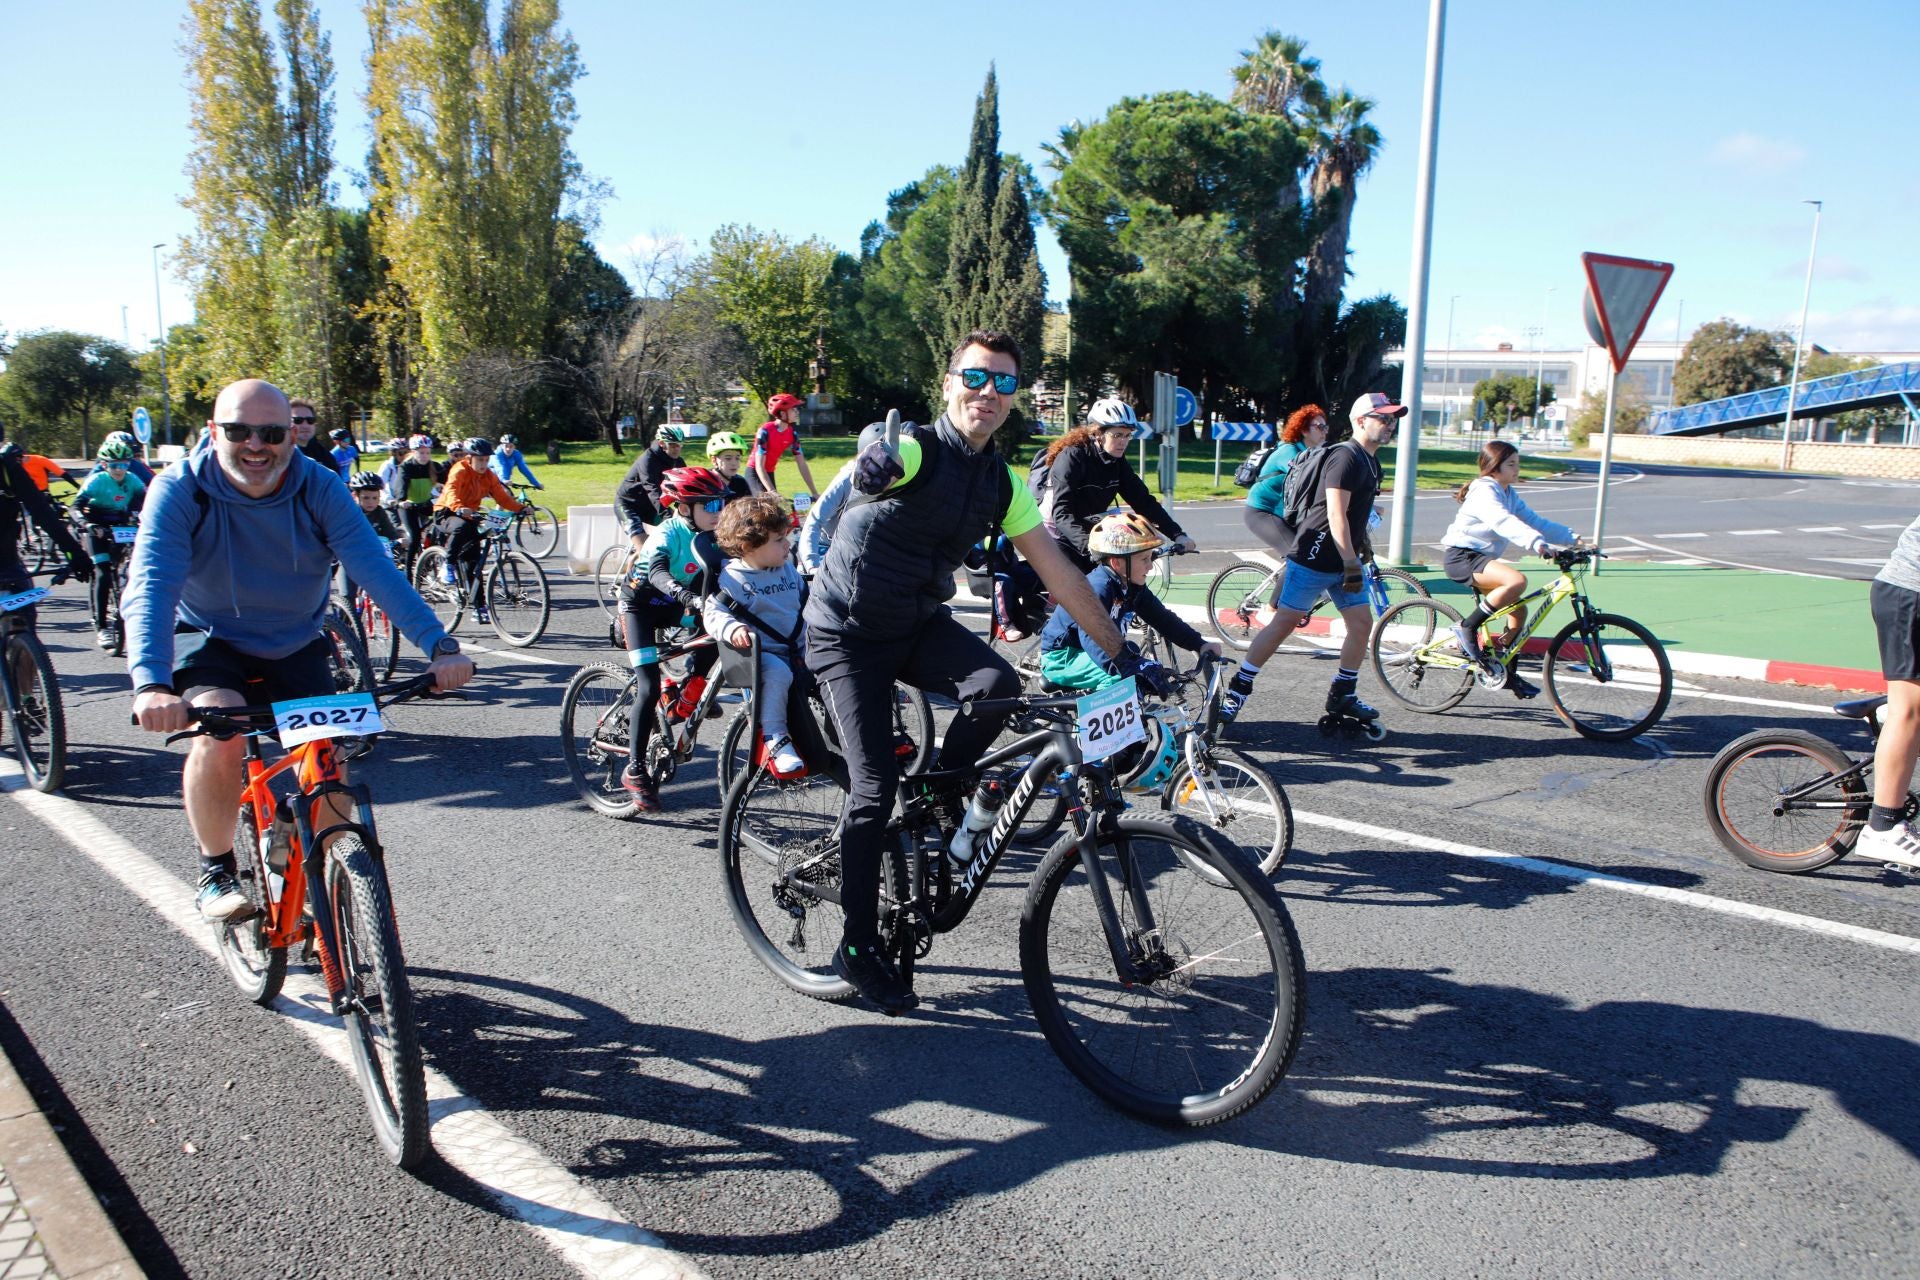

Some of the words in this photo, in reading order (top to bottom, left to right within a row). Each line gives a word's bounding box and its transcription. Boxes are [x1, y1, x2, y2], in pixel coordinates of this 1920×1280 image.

[1307, 531, 1327, 561] RVCA
[287, 707, 368, 731] 2027
[1088, 701, 1136, 742] 2025
[960, 769, 1035, 900] SPECIALIZED
